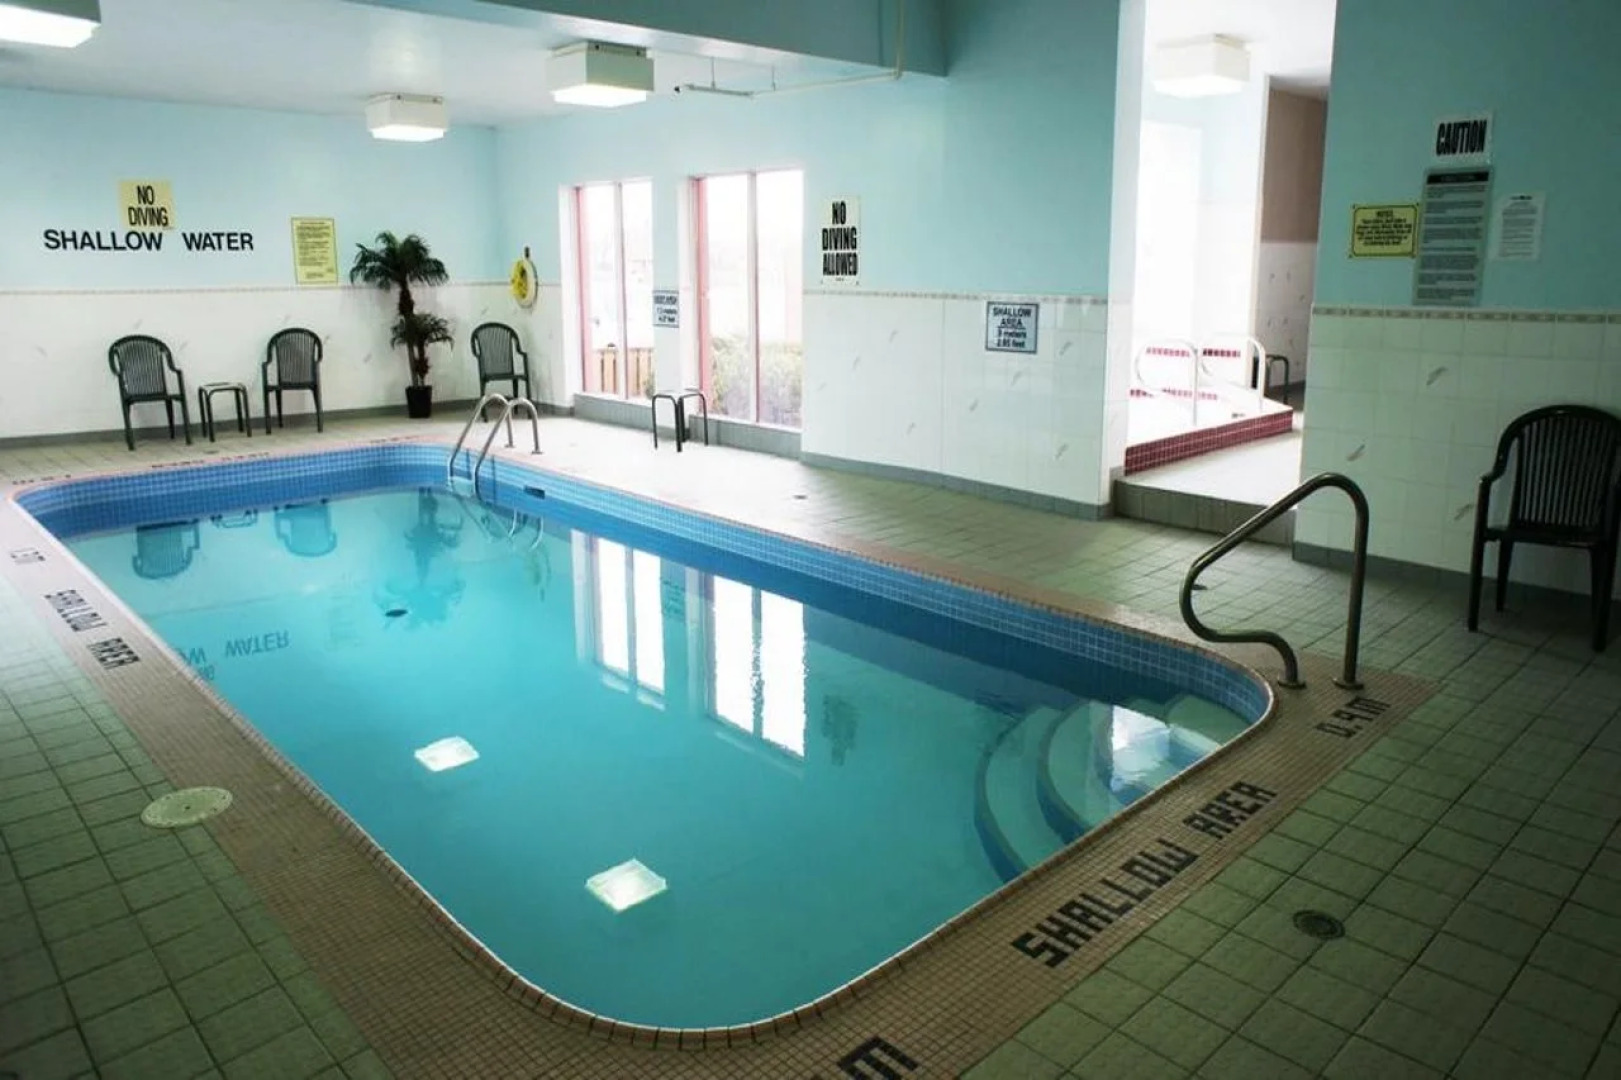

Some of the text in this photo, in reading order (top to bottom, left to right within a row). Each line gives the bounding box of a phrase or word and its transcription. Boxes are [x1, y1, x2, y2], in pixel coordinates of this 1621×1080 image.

[1436, 119, 1488, 156] CAUTION
[136, 185, 155, 206] NO
[127, 207, 169, 228] DIVING
[831, 200, 847, 225] NO
[44, 229, 253, 251] SHALLOW WATER
[821, 226, 857, 251] DIVING
[822, 252, 858, 277] ALLOWED
[993, 307, 1031, 317] SHALLOW
[1011, 780, 1278, 969] SHALLOW AREA
